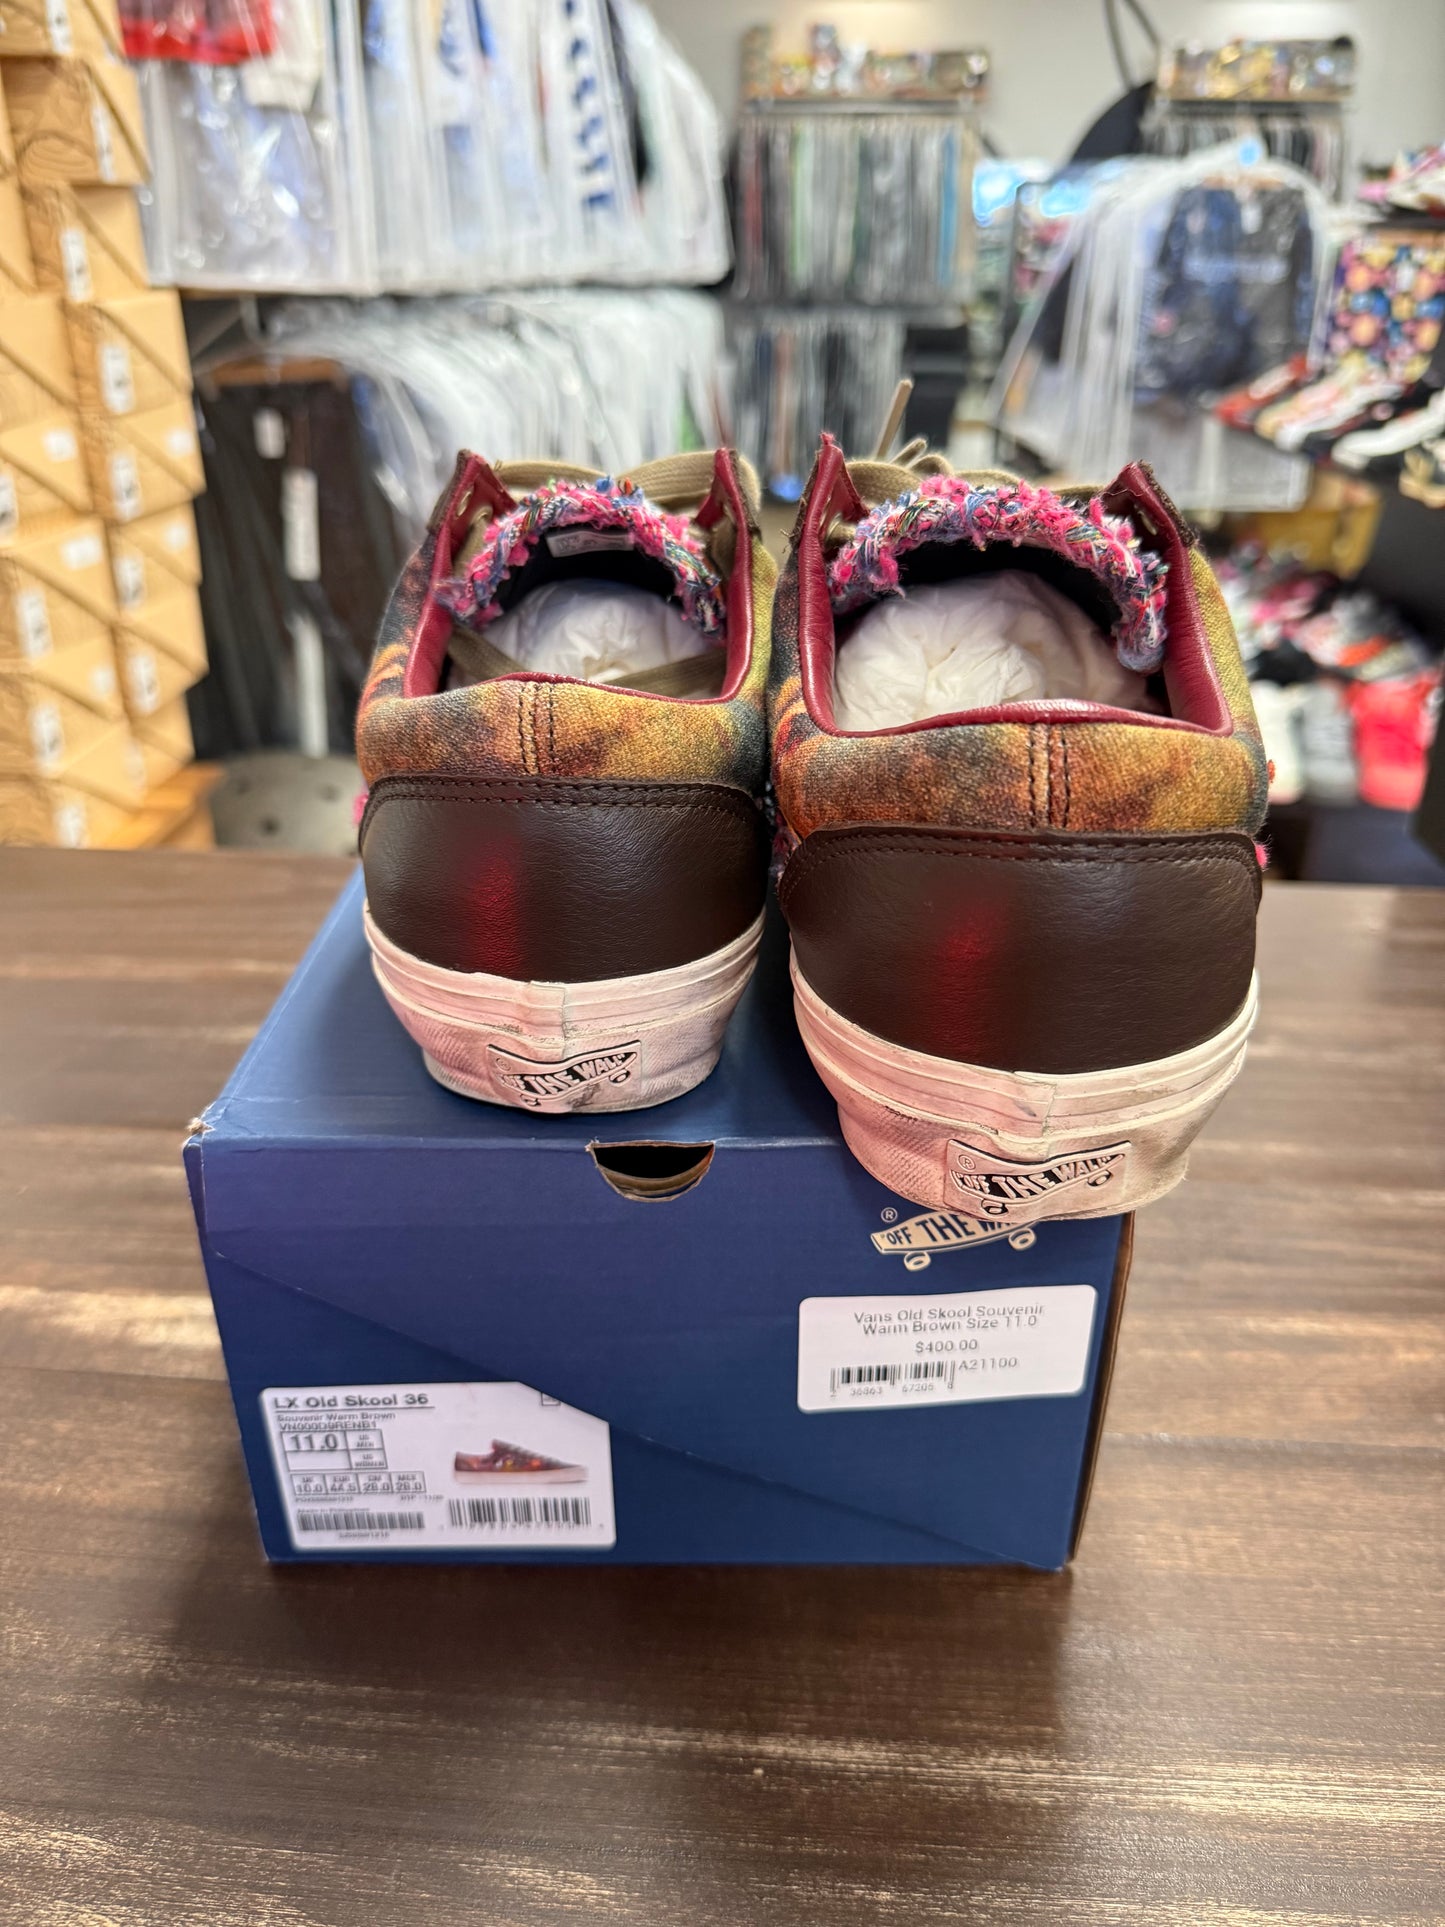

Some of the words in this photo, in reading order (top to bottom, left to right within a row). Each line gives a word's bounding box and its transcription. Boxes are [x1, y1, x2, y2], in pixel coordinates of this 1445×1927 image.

[526, 1070, 580, 1095] THE
[992, 1172, 1056, 1200] THE
[915, 1212, 976, 1243] THE
[854, 1312, 892, 1323] Vans
[897, 1309, 923, 1321] Old
[927, 1306, 971, 1320] Skool
[976, 1303, 1044, 1317] Souvenir
[862, 1323, 908, 1336] Warm
[912, 1320, 961, 1333] Brown
[966, 1317, 999, 1329] Size
[1004, 1315, 1037, 1328] 11.0
[915, 1338, 978, 1354] $400.00
[958, 1357, 1018, 1371] A21100
[274, 1397, 299, 1409] LX
[305, 1396, 338, 1408] Old
[345, 1394, 398, 1407] Skool
[404, 1393, 429, 1405] 36
[326, 1413, 358, 1421] Warm
[360, 1412, 396, 1420] Brown
[290, 1433, 338, 1450] 11.0
